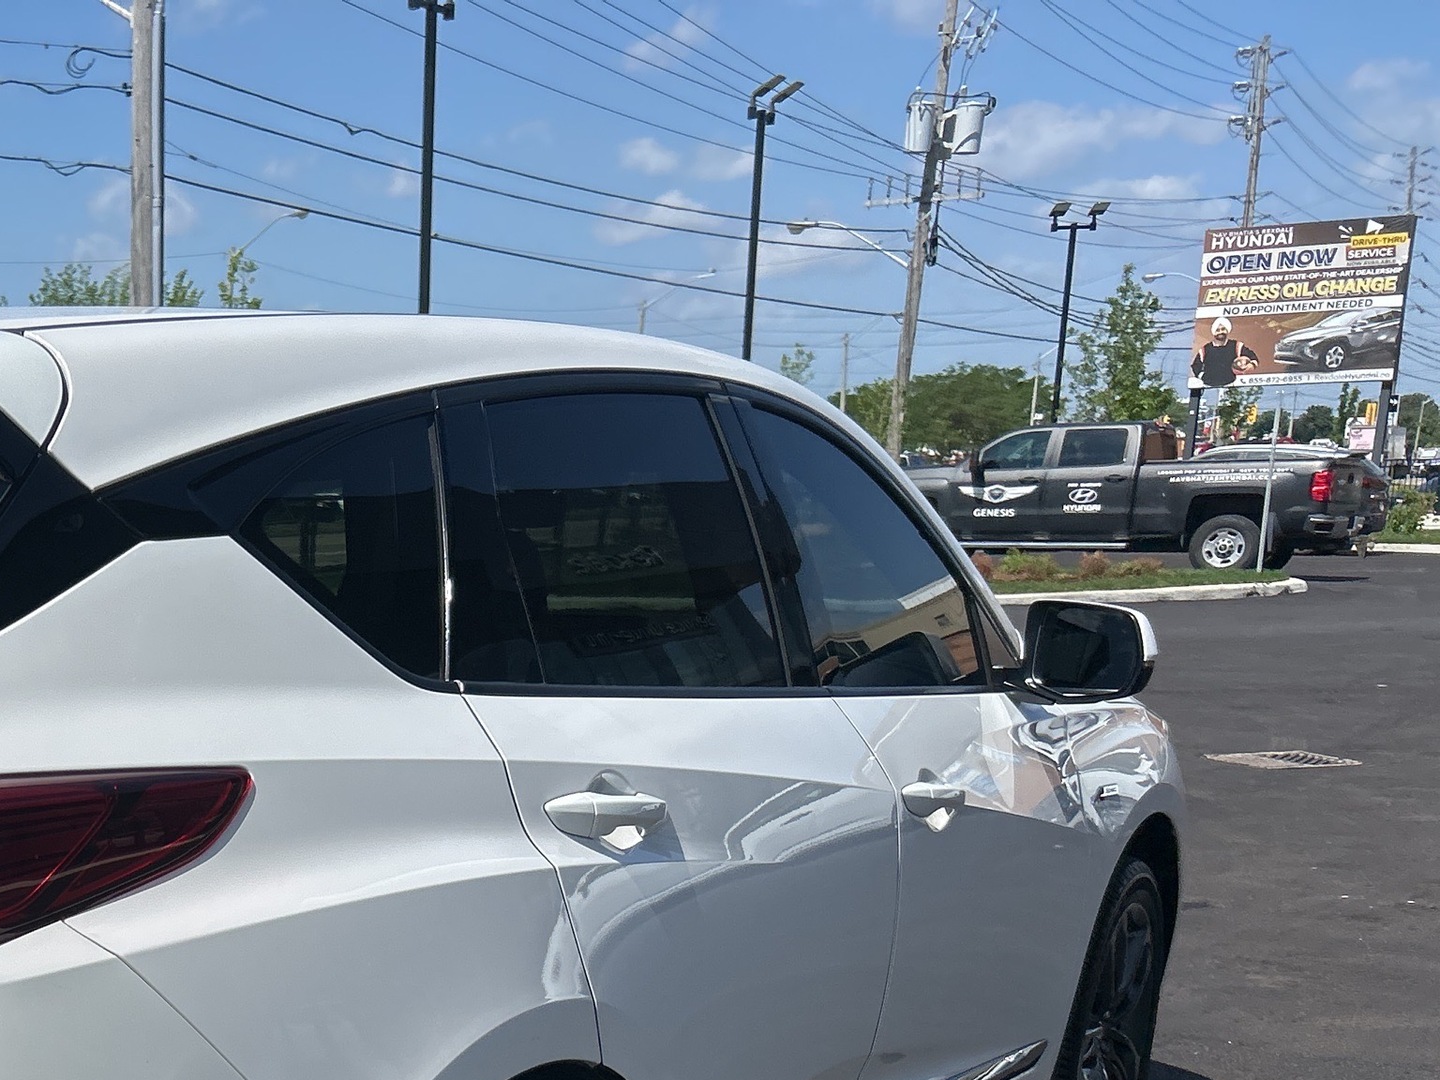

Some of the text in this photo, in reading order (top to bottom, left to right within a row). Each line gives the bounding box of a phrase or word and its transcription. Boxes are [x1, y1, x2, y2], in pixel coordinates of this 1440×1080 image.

[1211, 232, 1293, 250] HYUNDAI
[1352, 235, 1406, 246] DRIVE-THRU
[1348, 247, 1394, 259] SERVICE
[1207, 248, 1338, 274] OPEN NOW
[1247, 276, 1264, 284] OUR
[1203, 276, 1398, 305] EXPRESS OIL CHANGE
[1223, 299, 1373, 315] NO APPOINTMENT NEEDED
[973, 508, 1016, 518] GENESIS
[1063, 504, 1101, 512] HYUNDAI
